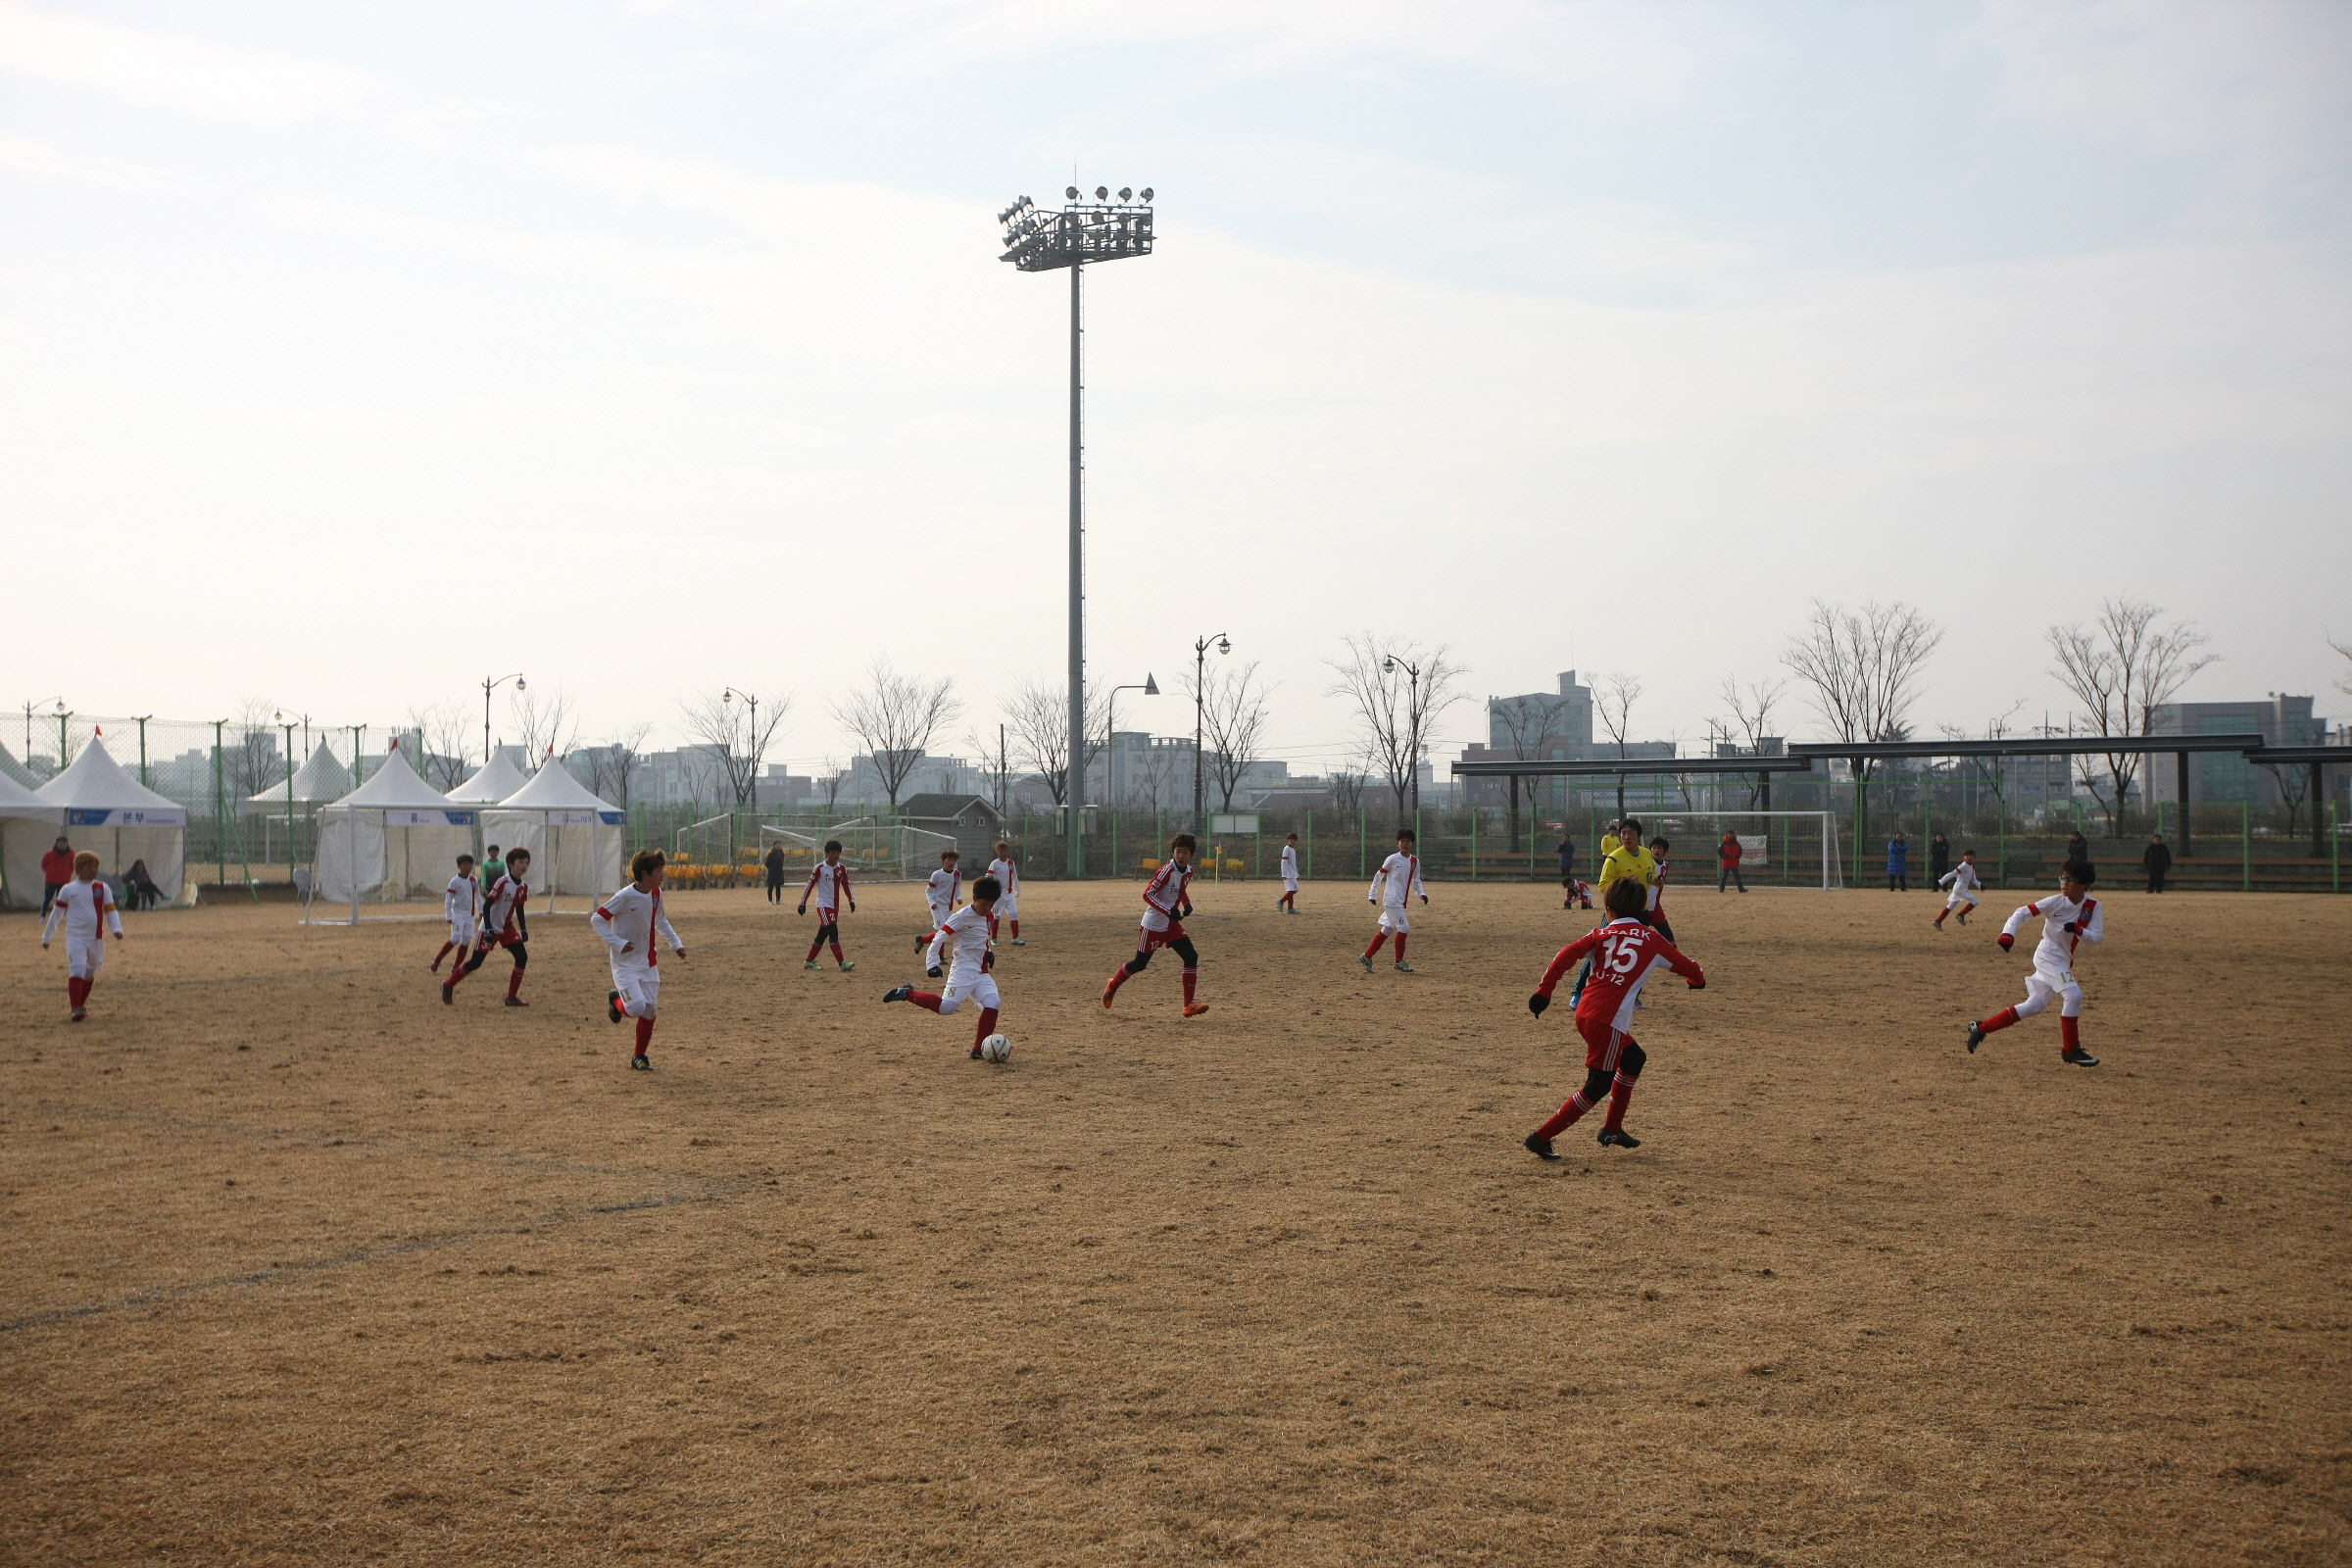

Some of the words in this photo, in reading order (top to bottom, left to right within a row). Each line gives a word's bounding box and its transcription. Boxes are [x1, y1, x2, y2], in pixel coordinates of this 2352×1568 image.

[122, 811, 145, 824] 본부
[1150, 941, 1160, 951] 12
[1603, 935, 1643, 973] 15
[1595, 970, 1626, 986] U-12
[2060, 971, 2075, 984] 12
[948, 987, 956, 998] 8
